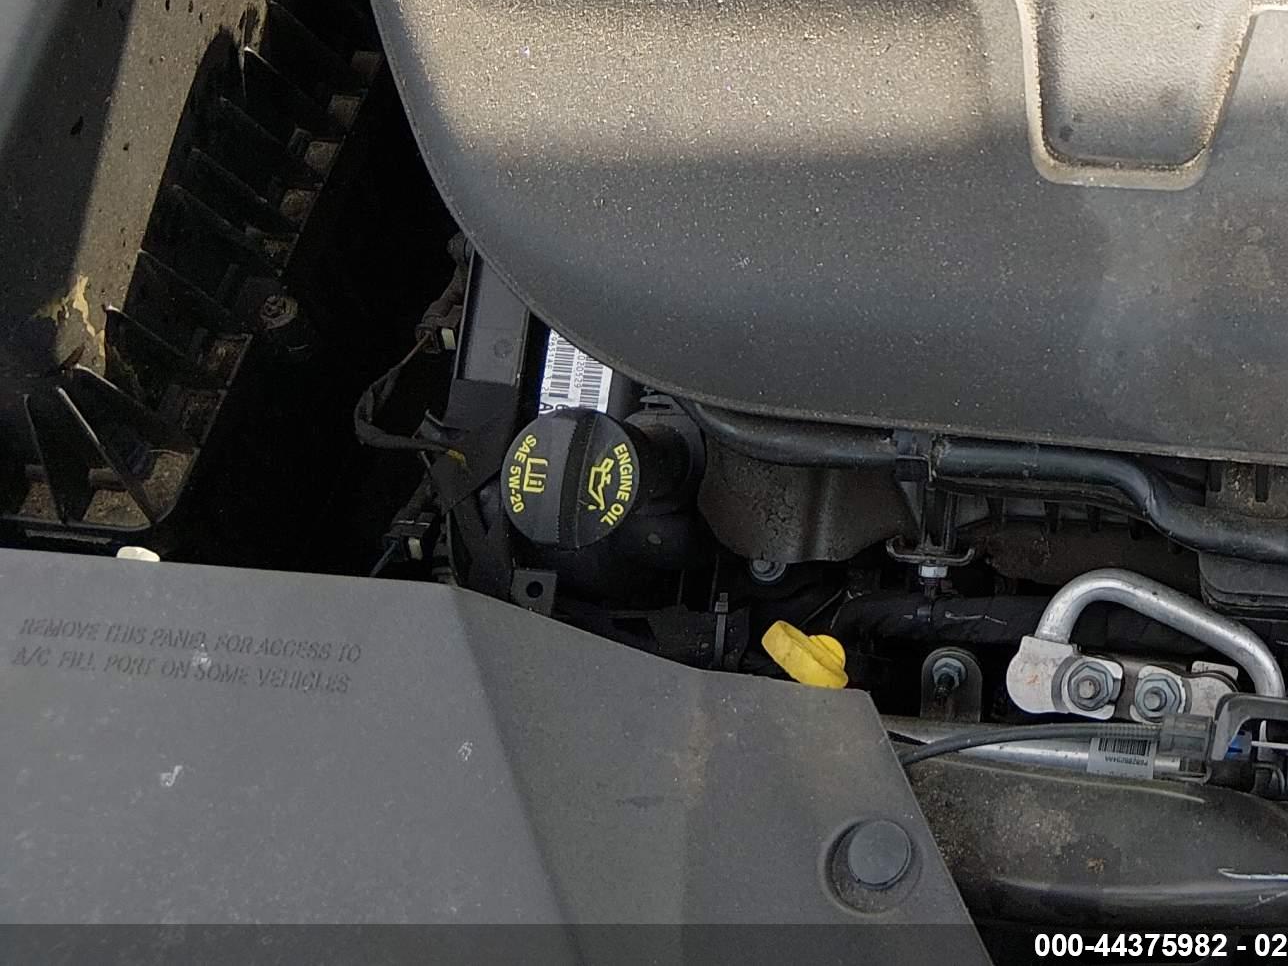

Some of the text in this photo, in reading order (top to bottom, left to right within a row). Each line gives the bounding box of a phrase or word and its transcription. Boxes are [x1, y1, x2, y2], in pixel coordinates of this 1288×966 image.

[508, 434, 537, 513] SAE 5W-20
[600, 443, 633, 526] ENGINE OIL
[19, 618, 99, 642] REMOVE
[104, 624, 148, 645] THIS
[215, 634, 254, 655] FOR
[255, 637, 332, 660] ACCESS
[338, 643, 362, 664] TO
[57, 651, 96, 672] FILL
[104, 654, 156, 676] PORT
[161, 659, 192, 680] ON
[193, 663, 249, 686] SOME
[258, 667, 352, 694] VEHICLES
